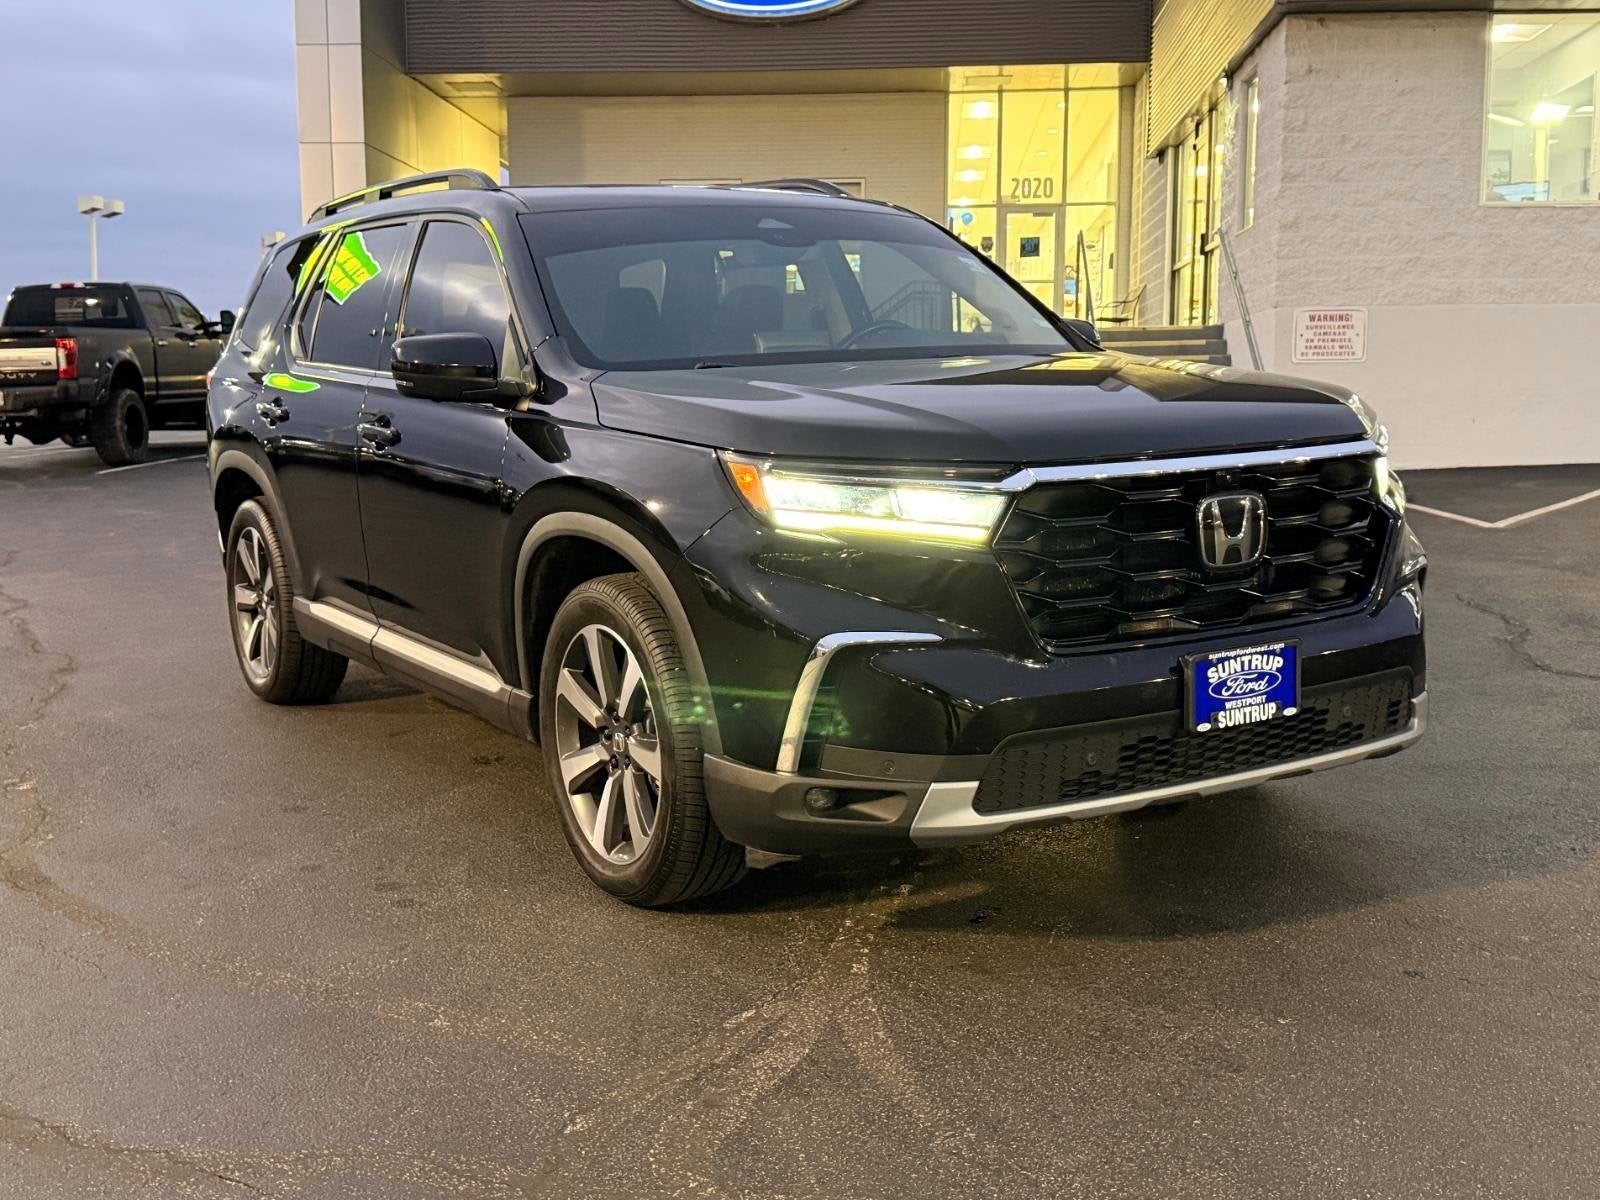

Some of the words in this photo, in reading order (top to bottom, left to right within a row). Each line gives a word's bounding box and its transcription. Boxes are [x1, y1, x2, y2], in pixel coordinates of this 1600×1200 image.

[1010, 177, 1054, 200] 2020
[1308, 313, 1353, 322] WARNING!
[1208, 643, 1285, 660] suntrupfordwest.com
[1207, 654, 1284, 684] SUNTRUP
[1221, 673, 1269, 696] Ford
[1224, 695, 1267, 710] WESTPORT
[1217, 702, 1277, 729] SUNTRUP
